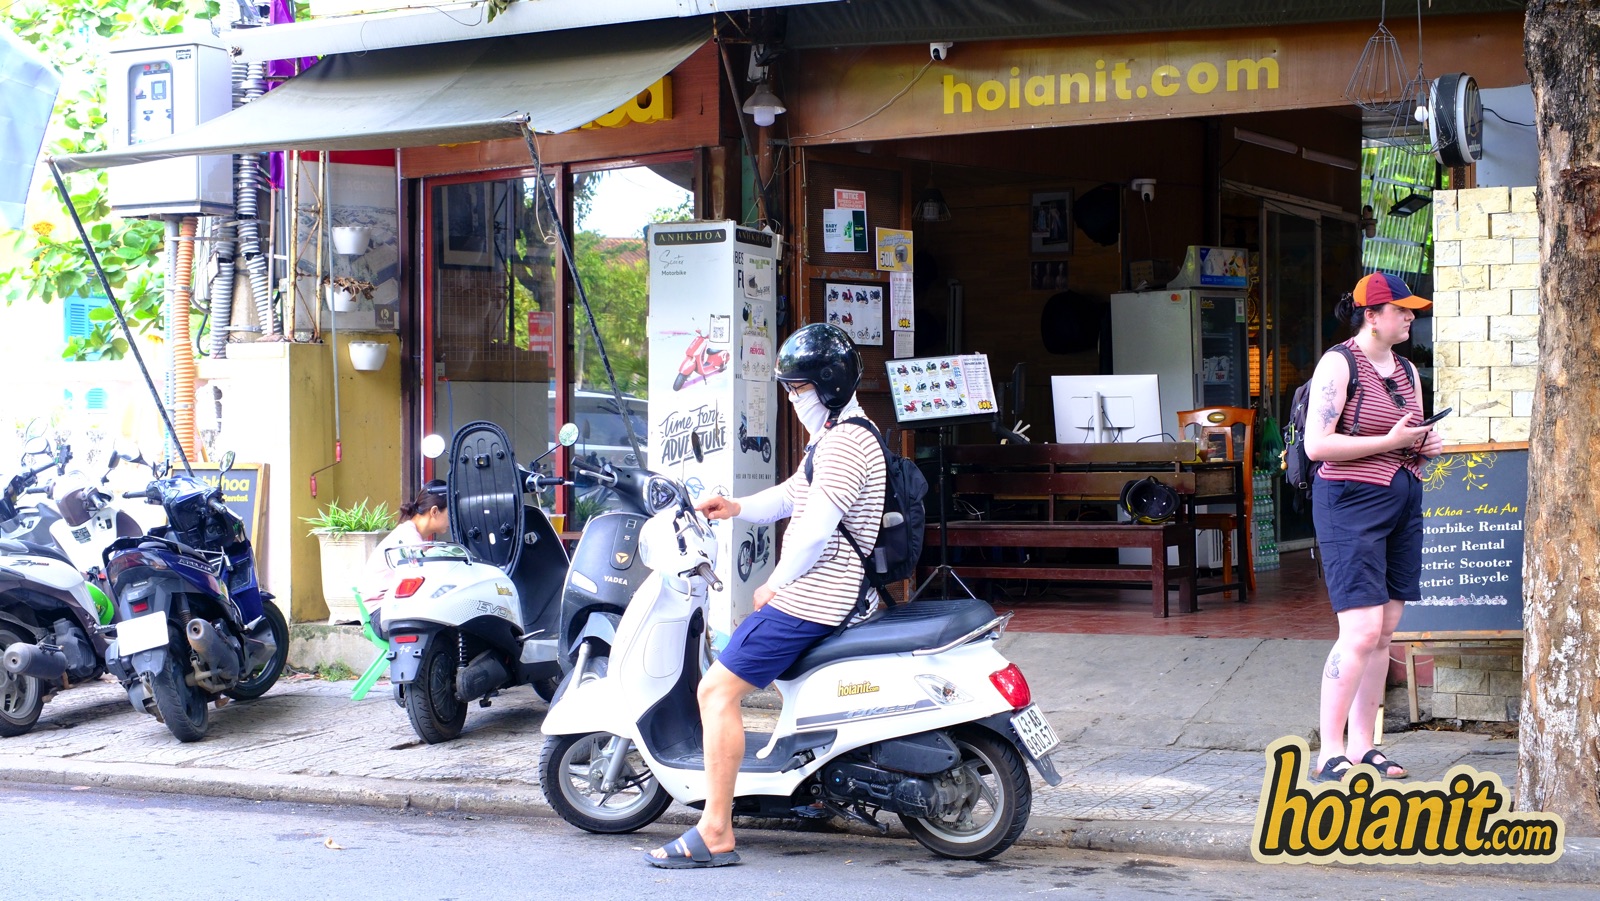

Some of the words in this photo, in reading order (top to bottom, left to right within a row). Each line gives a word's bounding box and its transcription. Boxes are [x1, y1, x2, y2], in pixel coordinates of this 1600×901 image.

[943, 57, 1280, 115] hoianit.com
[658, 231, 722, 242] ANHKHOA
[880, 251, 895, 268] 50K
[659, 411, 694, 437] Time
[662, 426, 727, 464] ADVETURE
[1434, 506, 1463, 517] Khoa
[1474, 503, 1498, 515] Hoi
[1500, 502, 1518, 515] An
[1422, 522, 1474, 535] otorbike
[1479, 520, 1523, 532] Rental
[1422, 544, 1457, 555] ooter
[1462, 539, 1505, 551] Rental
[1421, 559, 1455, 571] ectric
[1460, 558, 1513, 569] Scooter
[603, 575, 628, 586] YADEA
[1419, 576, 1454, 588] ectric
[1459, 571, 1509, 587] Bicycle
[837, 680, 880, 697] hoianit.com
